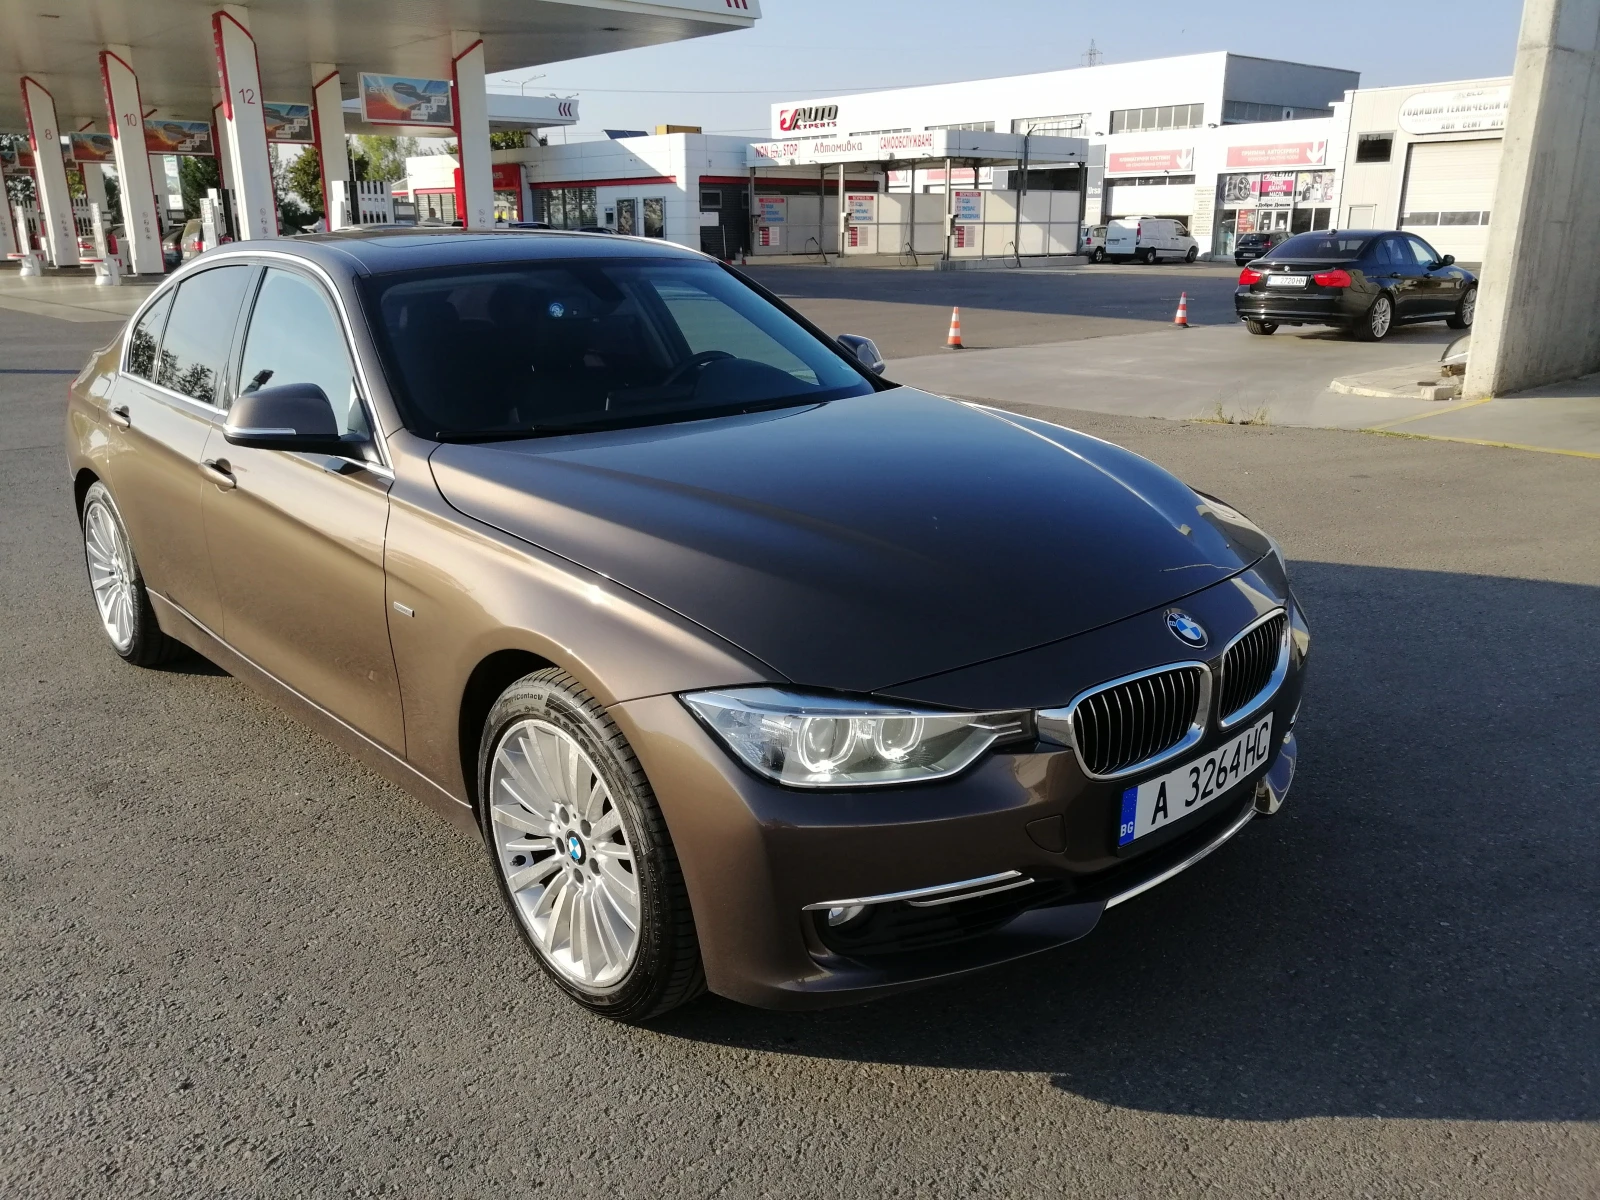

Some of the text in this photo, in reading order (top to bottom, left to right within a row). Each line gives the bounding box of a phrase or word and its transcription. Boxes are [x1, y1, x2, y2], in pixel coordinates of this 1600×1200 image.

[239, 88, 255, 104] 12
[123, 113, 137, 127] 10
[792, 104, 838, 128] AUTO
[795, 121, 837, 130] EXPERTS
[44, 129, 53, 140] 8
[880, 133, 932, 150] САМООБСЛУЖВАНЕ
[755, 143, 798, 158] NON STOP
[813, 140, 863, 154] Автомивка
[1151, 721, 1269, 825] A 3264HC
[1120, 821, 1134, 838] BG
